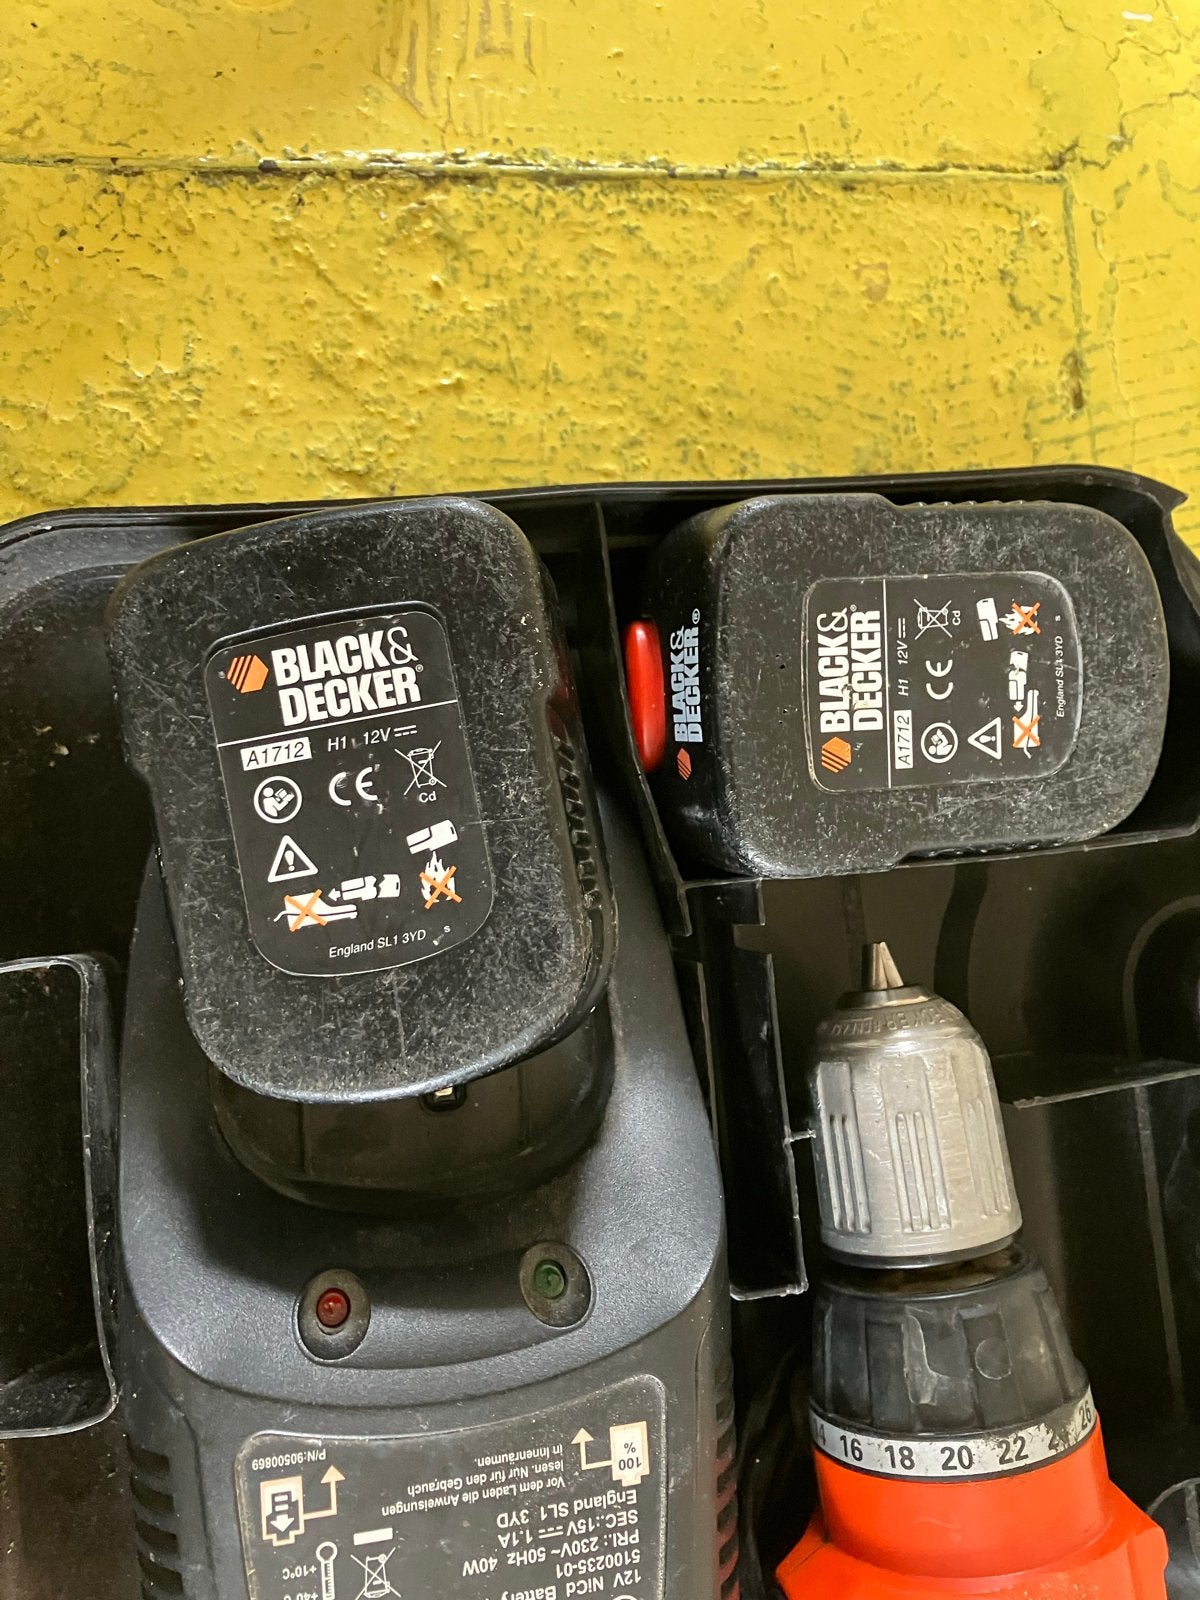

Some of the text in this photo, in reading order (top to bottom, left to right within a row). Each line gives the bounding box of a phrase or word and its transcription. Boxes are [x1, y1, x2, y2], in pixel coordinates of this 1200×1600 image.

[952, 610, 961, 626] Cd
[1054, 635, 1064, 657] 3YD
[896, 640, 909, 697] H1 12V
[925, 659, 954, 700] CE
[1055, 680, 1067, 718] England
[328, 727, 392, 752] H1 12V
[897, 714, 912, 766] A1712
[246, 741, 306, 768] A1712
[328, 766, 379, 807] CE
[418, 791, 437, 804] Cd
[329, 929, 427, 959] England SL1 3YD
[839, 1434, 864, 1462] 16
[884, 1445, 915, 1470] 18
[940, 1445, 974, 1471] 20
[996, 1435, 1029, 1465] 22
[1078, 1400, 1091, 1430] 26
[252, 1448, 327, 1471] P/N:90500869
[474, 1443, 564, 1467] in Innenräumen.
[623, 1442, 637, 1454] %
[618, 1456, 642, 1471] 100
[407, 1461, 564, 1497] lesen. Nur für den Gebrauch
[381, 1476, 566, 1517] Vor dem Laden die Anweisungen
[496, 1489, 637, 1528] England SL1 3YD
[497, 1529, 534, 1549] 1.1A
[604, 1528, 640, 1548] PRI.:
[462, 1557, 498, 1577] 40W
[507, 1547, 546, 1567] 50Hz
[556, 1549, 641, 1579] 5100235-01
[281, 1564, 317, 1581] +10°C
[613, 1568, 642, 1588] 12V
[566, 1576, 604, 1598] NiCd
